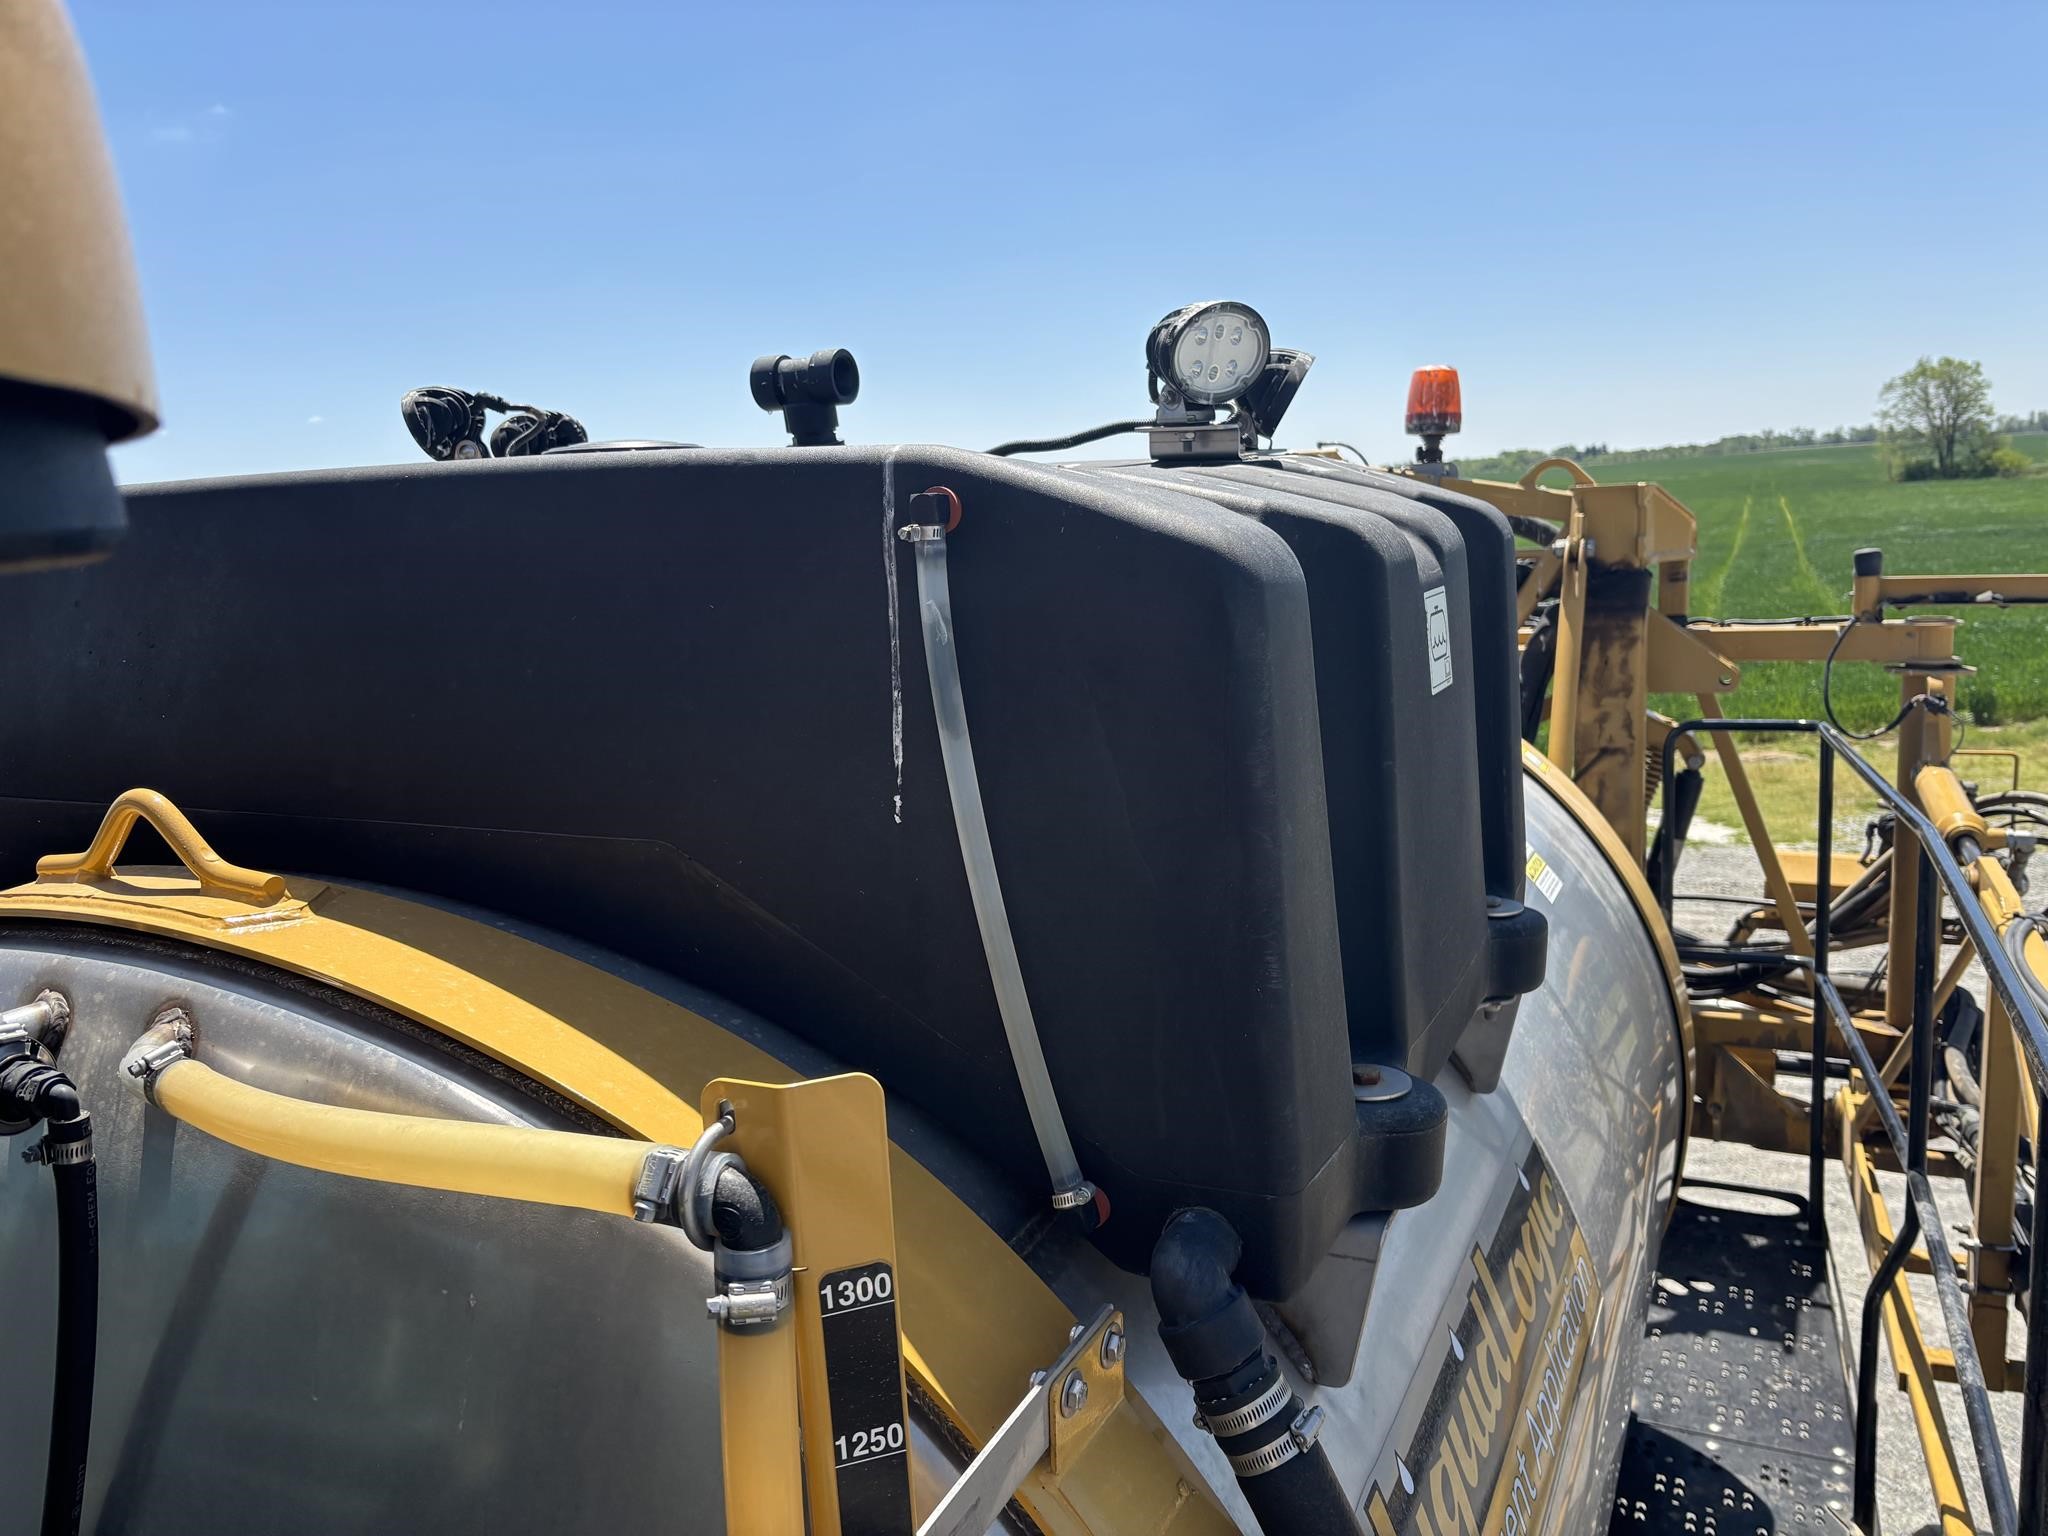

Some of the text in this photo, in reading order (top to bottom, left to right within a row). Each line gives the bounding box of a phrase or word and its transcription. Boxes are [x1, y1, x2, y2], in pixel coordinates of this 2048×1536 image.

[820, 1272, 892, 1310] 1300
[1500, 1254, 1591, 1536] ent Application
[835, 1422, 904, 1461] 1250
